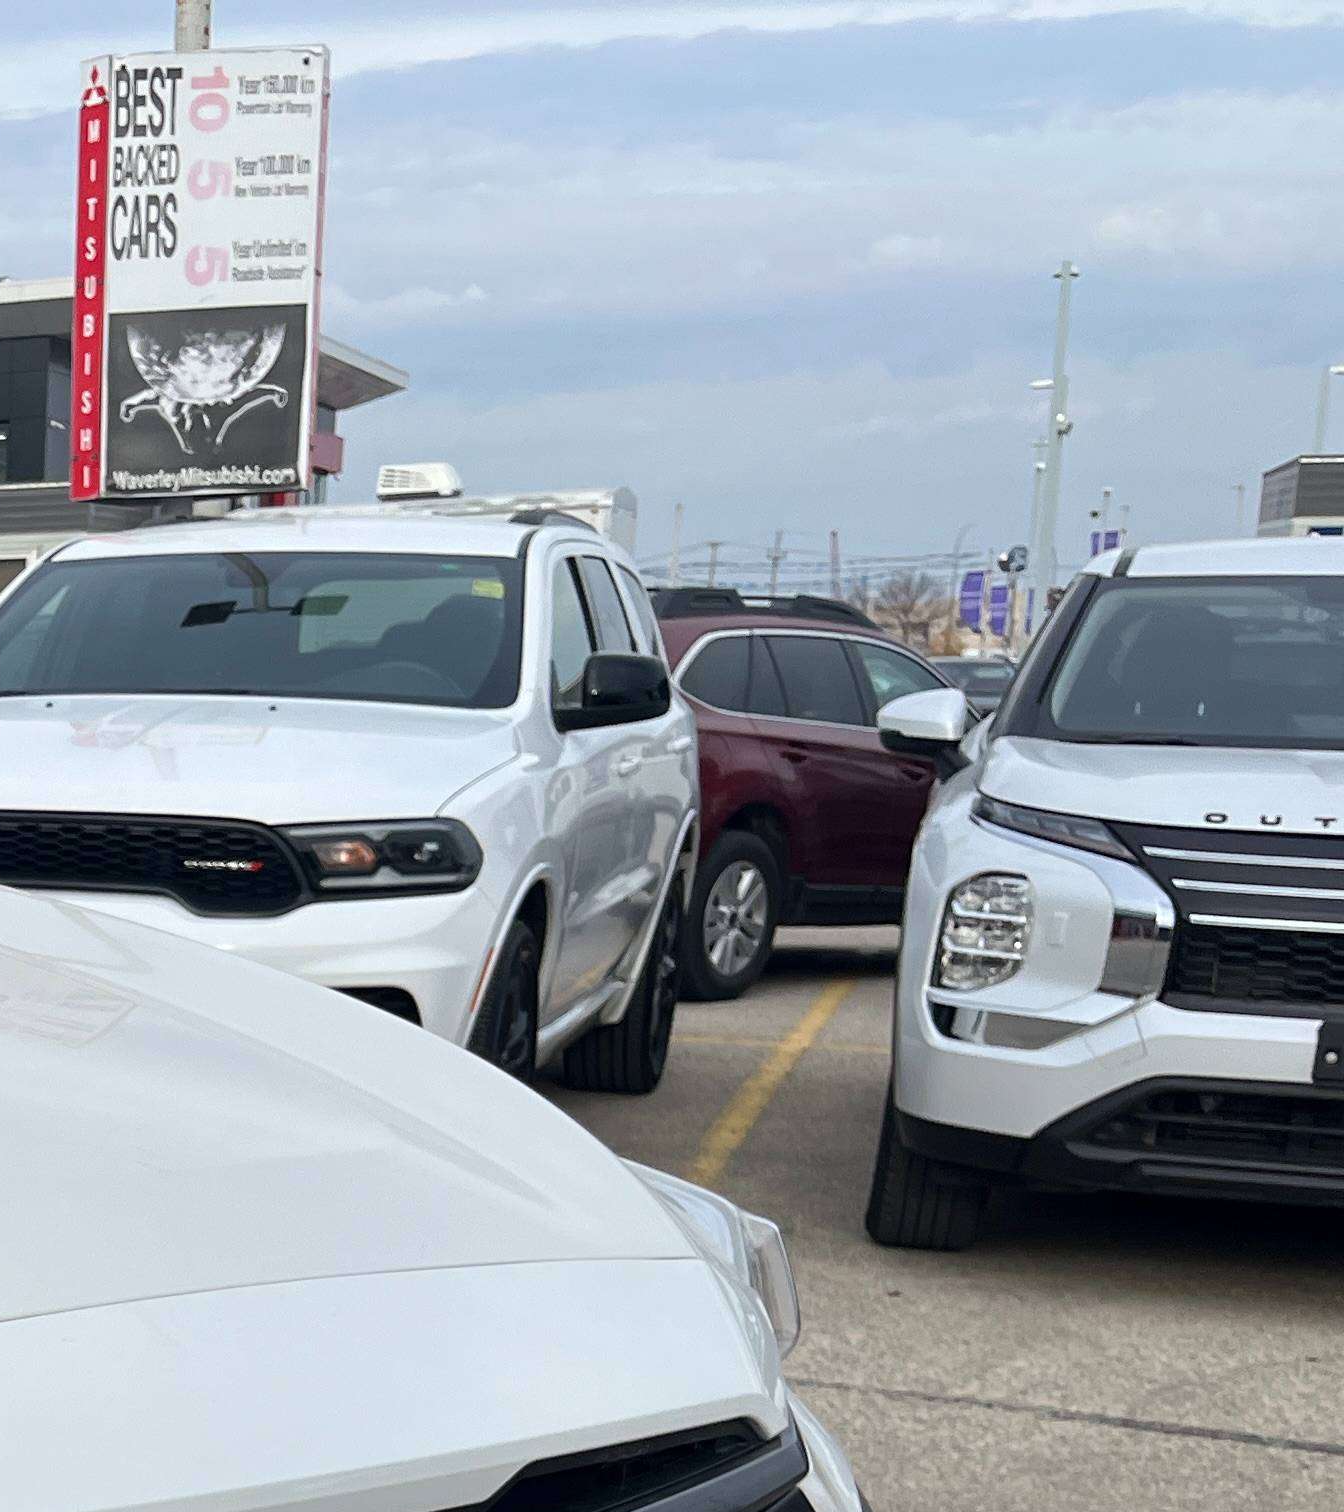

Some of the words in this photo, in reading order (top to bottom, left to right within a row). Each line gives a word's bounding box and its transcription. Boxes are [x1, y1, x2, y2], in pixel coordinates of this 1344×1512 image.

[115, 66, 183, 138] BEST
[188, 66, 231, 134] 10
[113, 143, 180, 187] BACKED
[187, 159, 233, 201] 5
[111, 192, 178, 261] CARS
[185, 245, 230, 287] 5
[79, 117, 102, 489] MITSUBISHI
